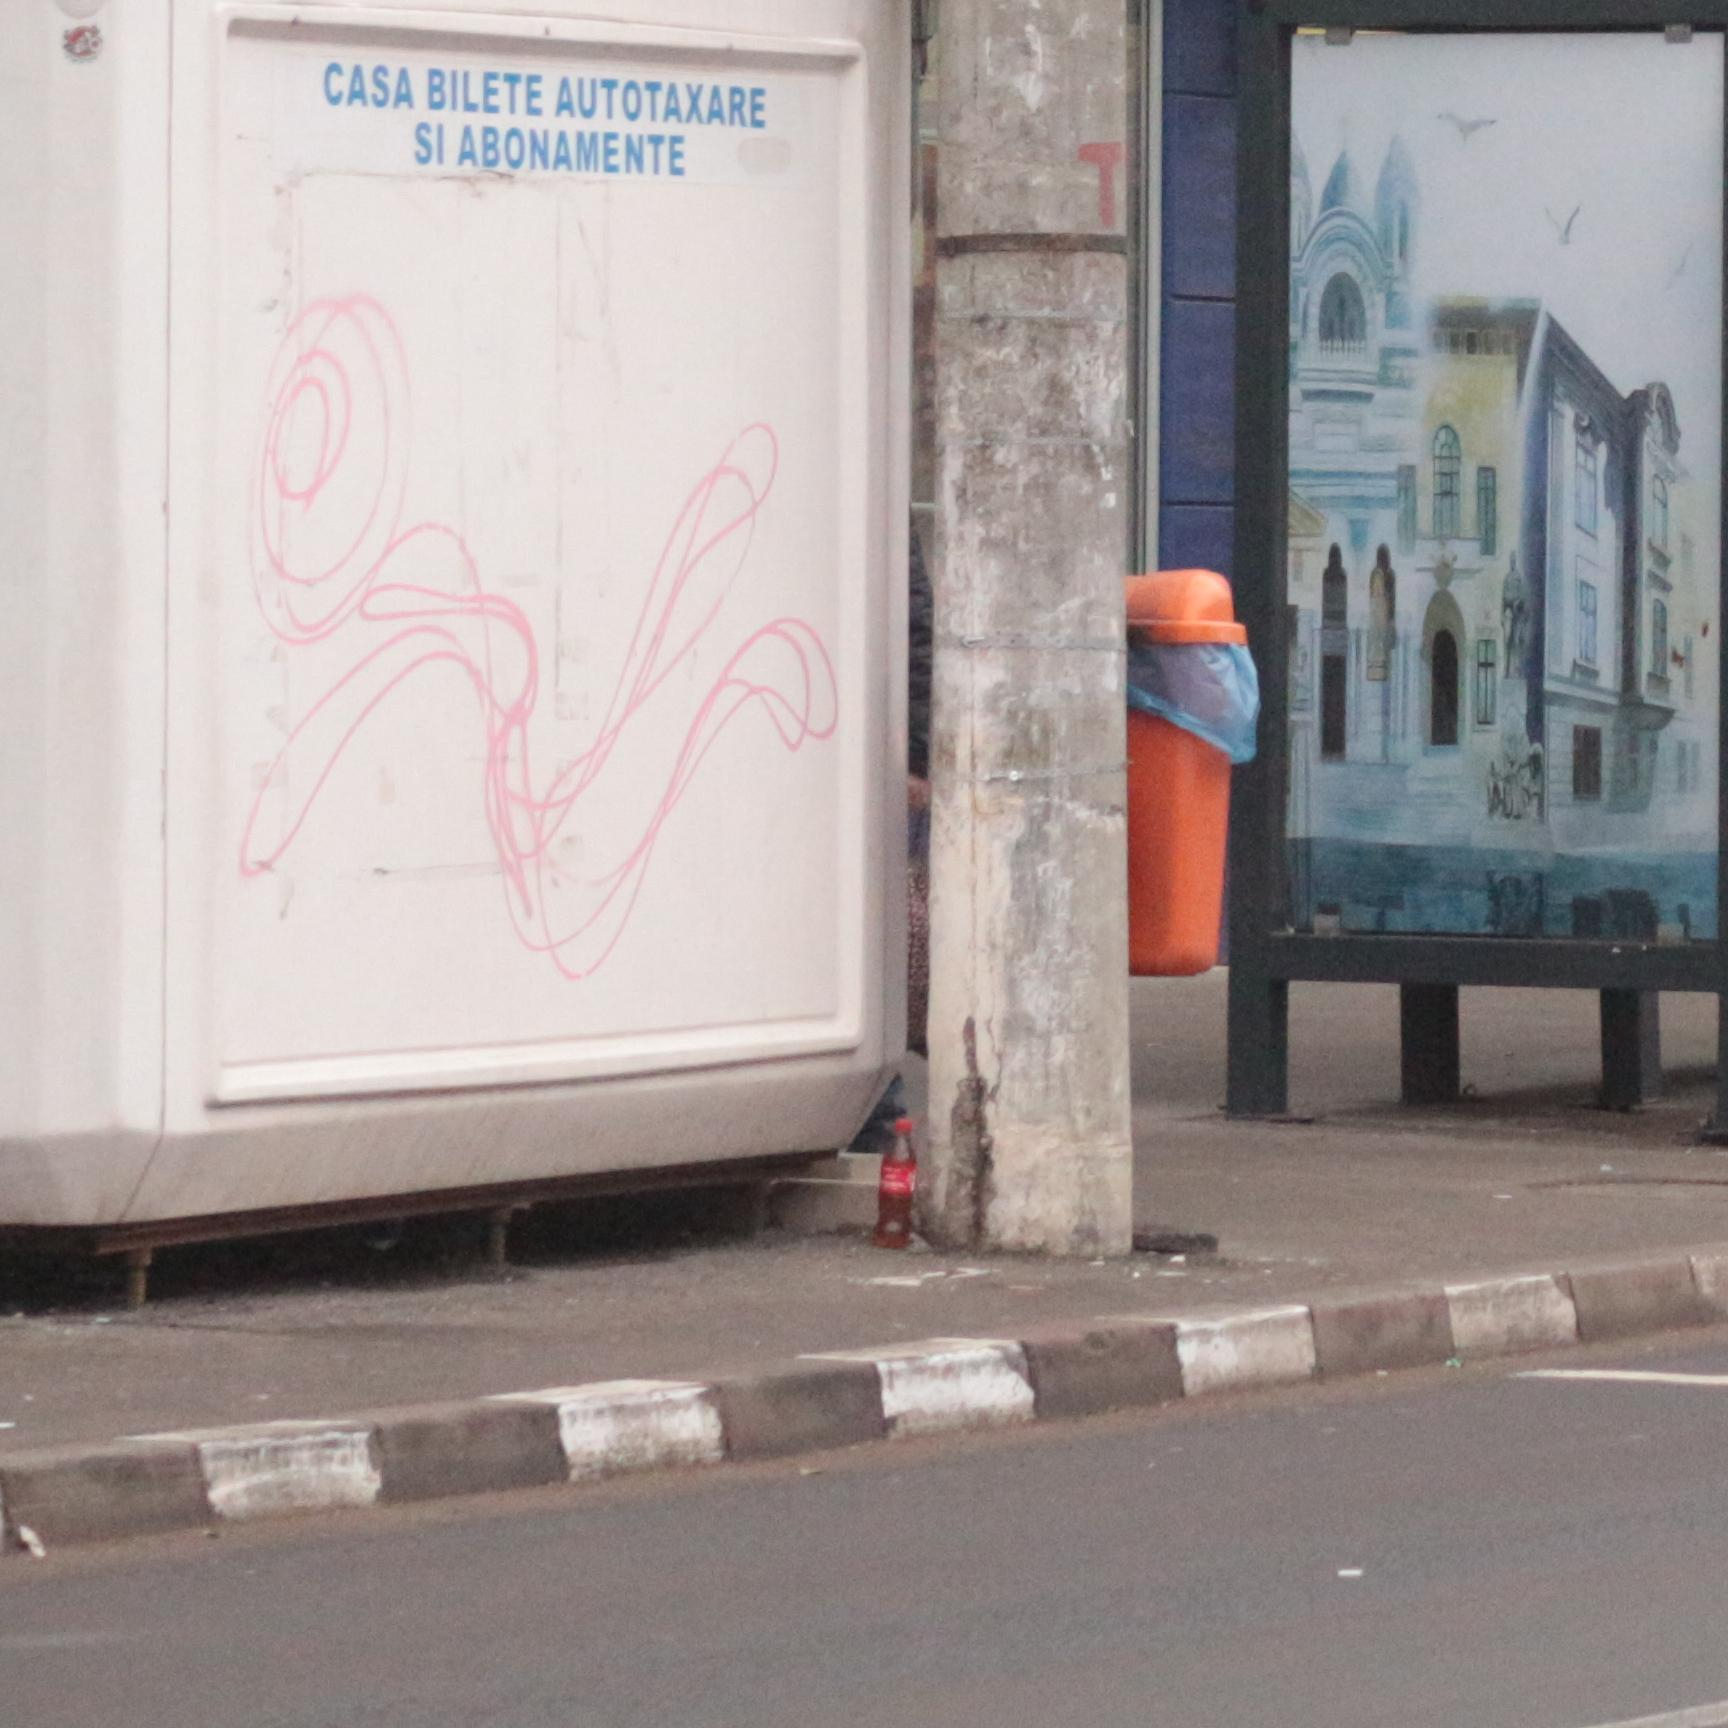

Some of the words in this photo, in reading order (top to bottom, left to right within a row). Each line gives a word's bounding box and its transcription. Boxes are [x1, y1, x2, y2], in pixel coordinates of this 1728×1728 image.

[324, 61, 414, 110] CASA
[426, 68, 543, 118] BILETE
[554, 76, 768, 130] AUTOTAXARE
[414, 121, 444, 166] SI
[457, 125, 686, 177] ABONAMENTE
